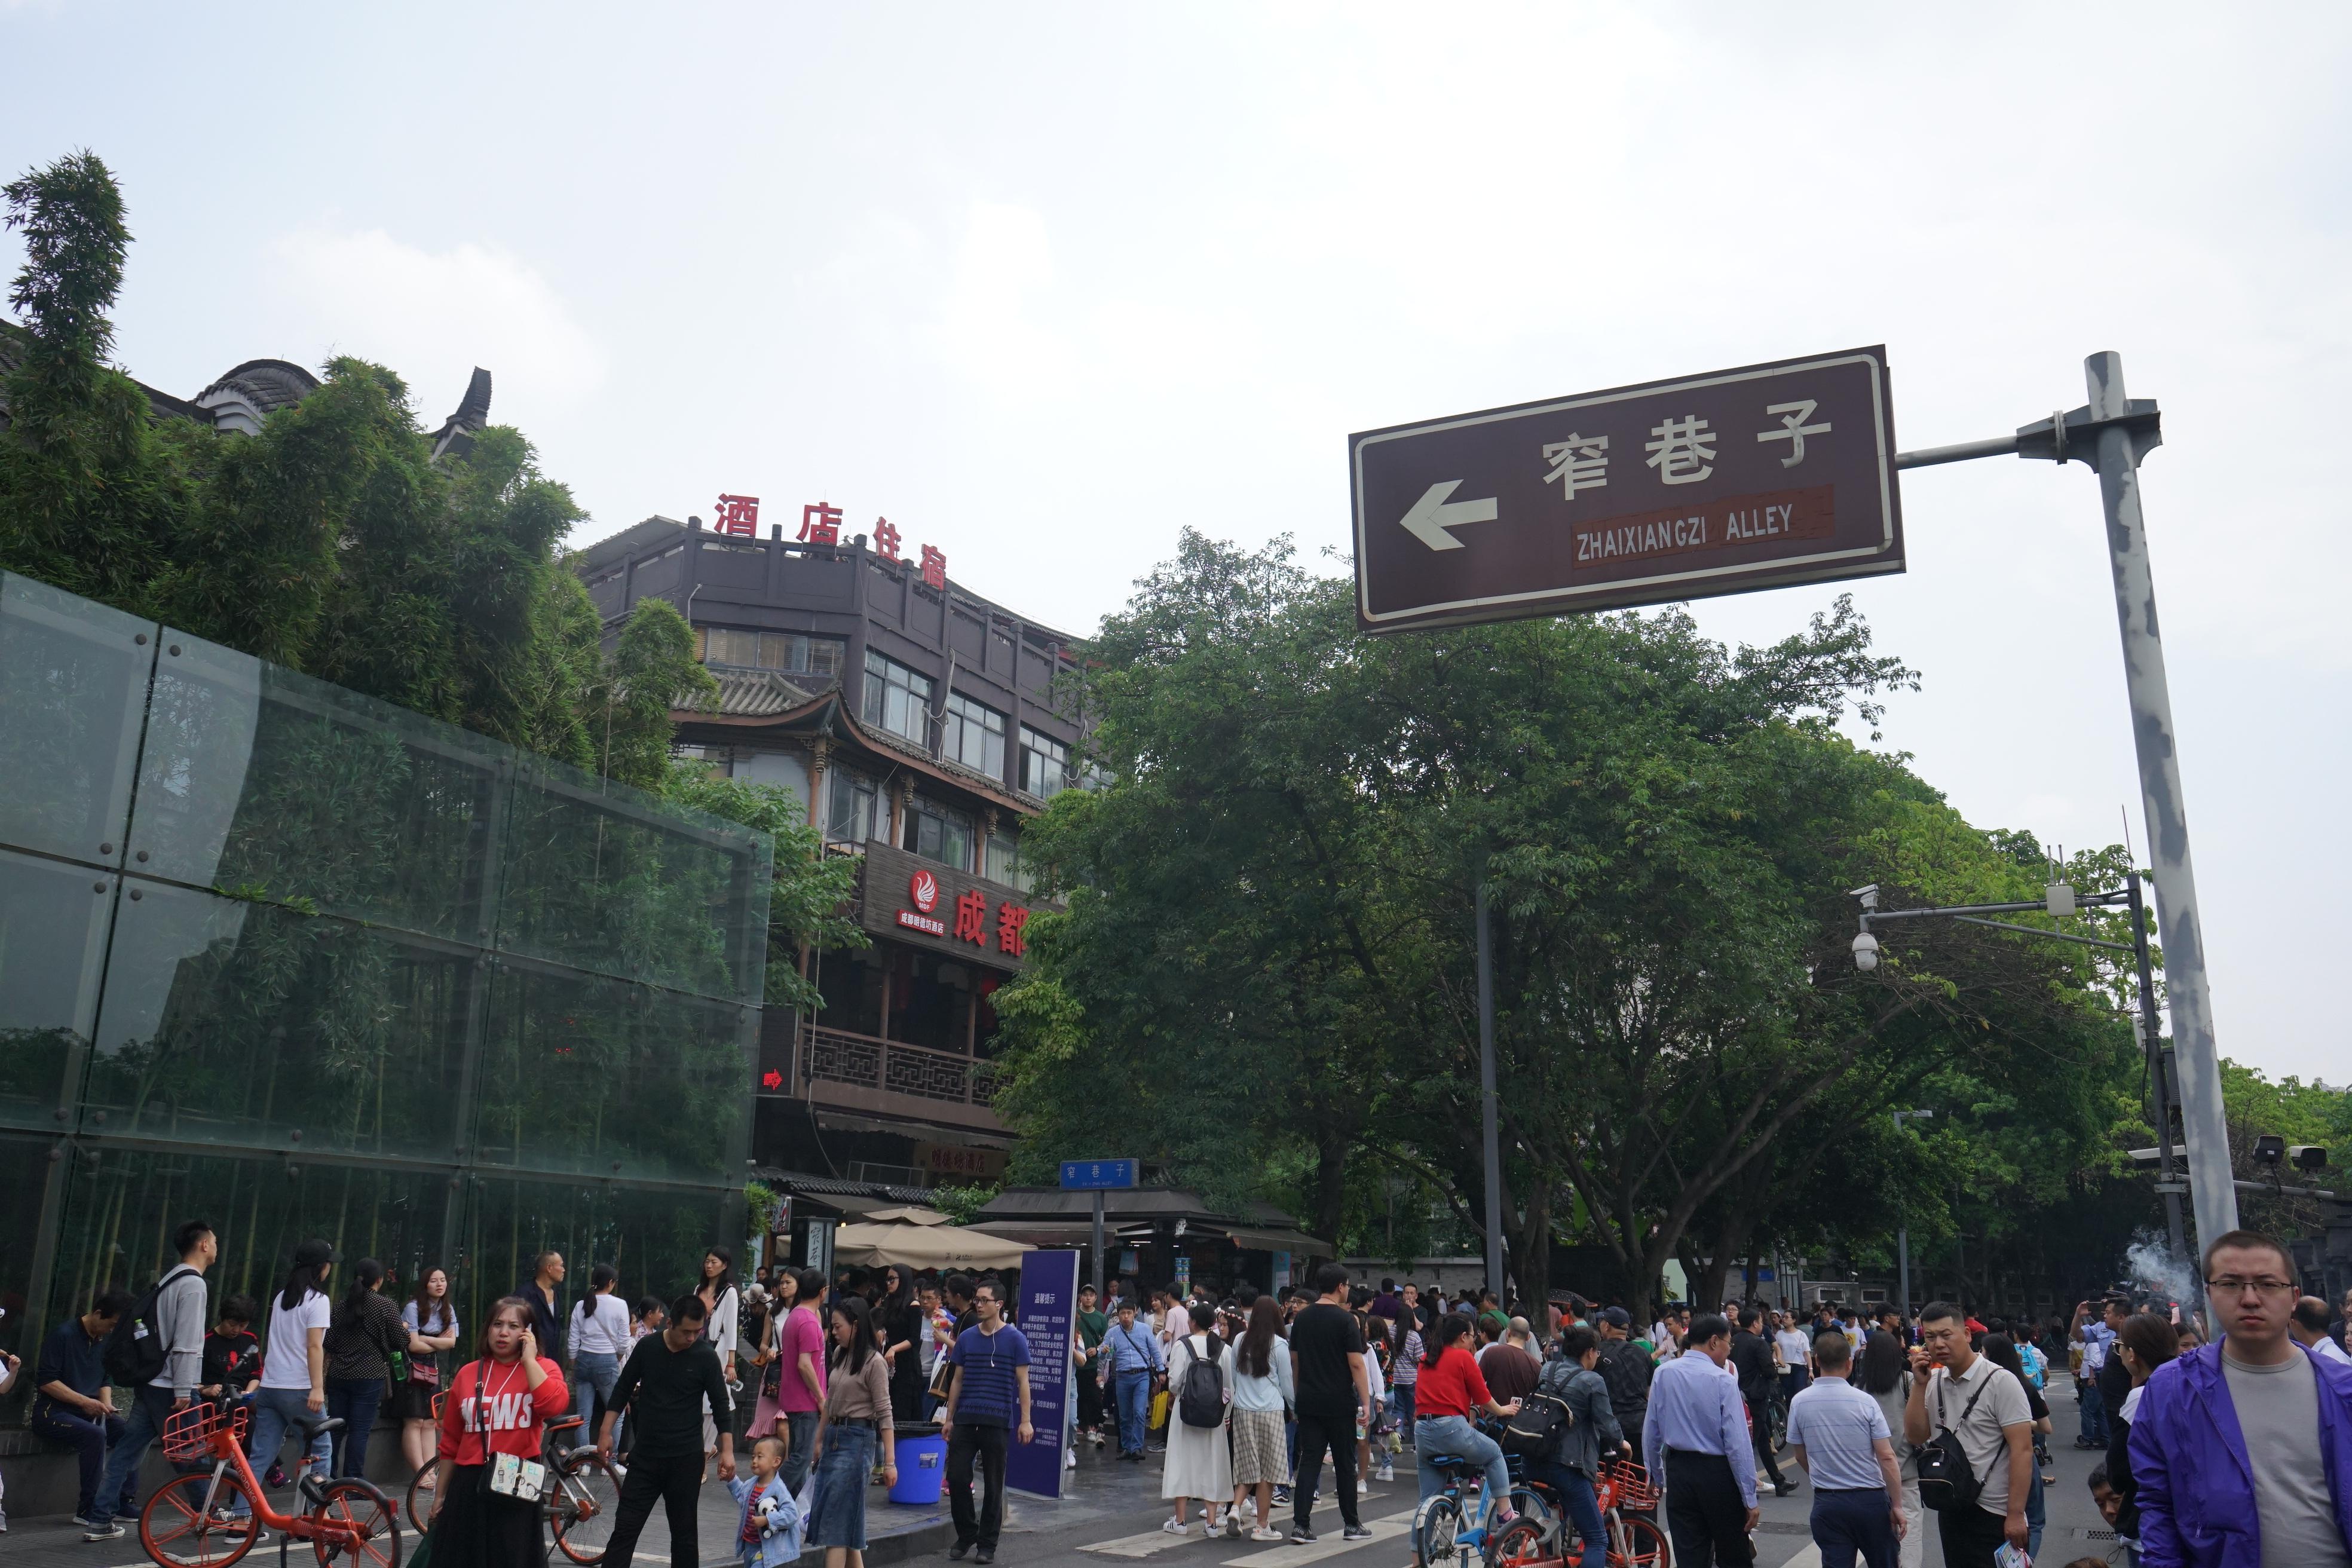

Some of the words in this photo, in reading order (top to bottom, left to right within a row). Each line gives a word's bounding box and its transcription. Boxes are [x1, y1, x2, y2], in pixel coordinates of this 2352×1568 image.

[1543, 399, 1832, 500] 窄巷子
[714, 493, 947, 590] 酒店住宿
[1577, 517, 1706, 562] ZHAIXIANGZI
[1726, 503, 1793, 540] ALLEY
[901, 912, 944, 933] 成都明德坊酒店
[954, 890, 1030, 956] 成都
[1067, 1164, 1124, 1179] 窄巷子
[1034, 1293, 1055, 1304] 温馨提示
[461, 1393, 533, 1432] NEWS
[235, 1466, 257, 1503] mobike
